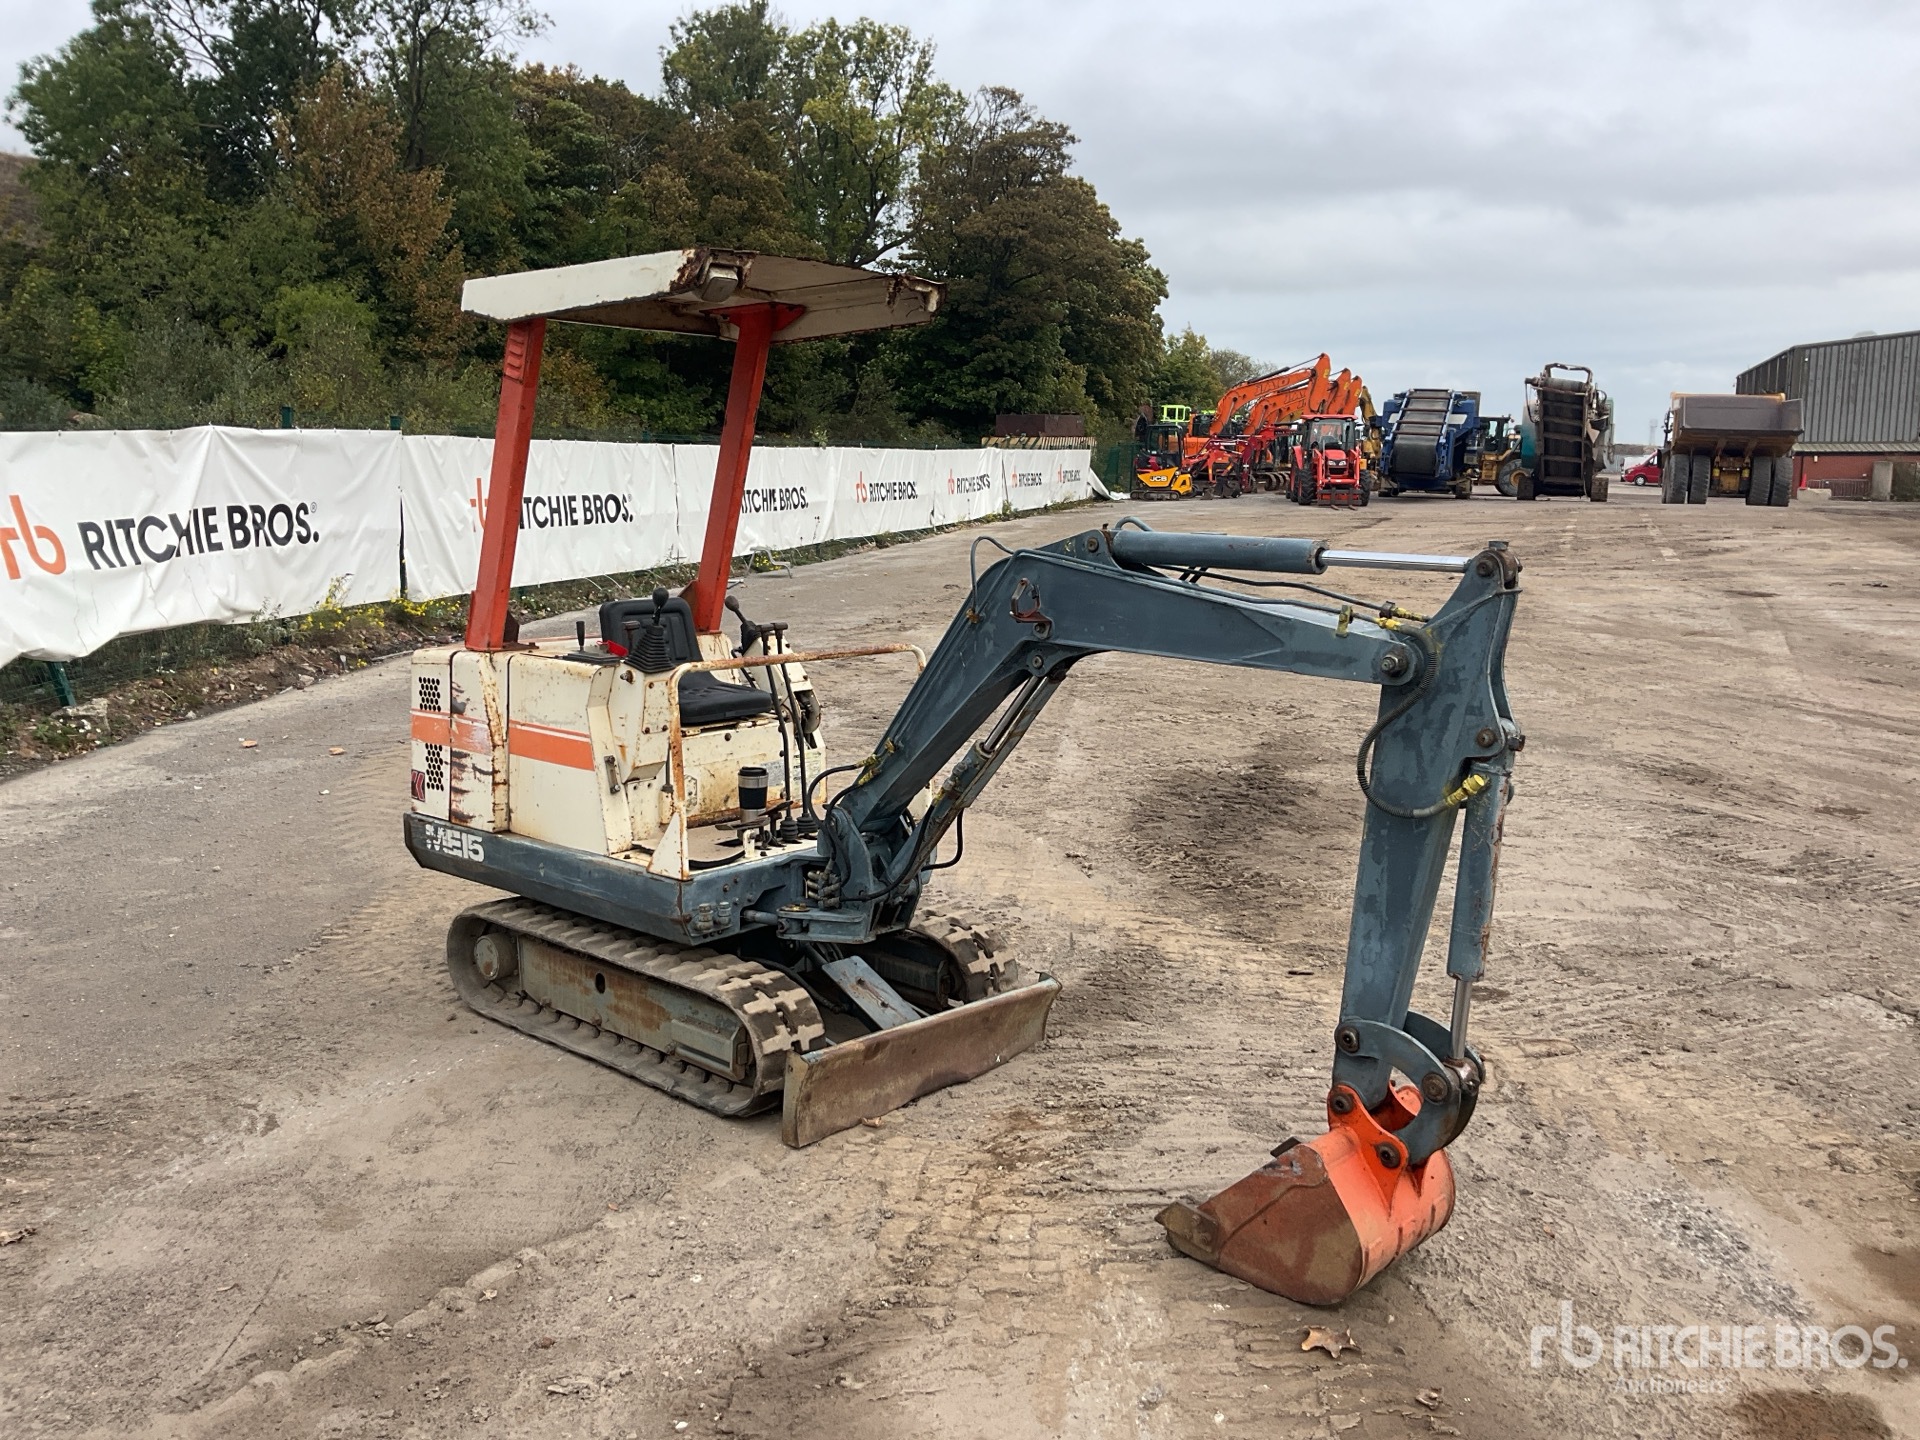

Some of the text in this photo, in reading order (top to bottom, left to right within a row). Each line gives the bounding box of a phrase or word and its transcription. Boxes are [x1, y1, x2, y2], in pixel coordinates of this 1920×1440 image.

[742, 486, 808, 514] ITCHIE BROS.
[856, 471, 867, 503] rb
[869, 482, 897, 502] RITCHIE
[582, 493, 633, 525] BROS.
[77, 506, 223, 570] RITCHIE
[226, 502, 320, 549] BROS.
